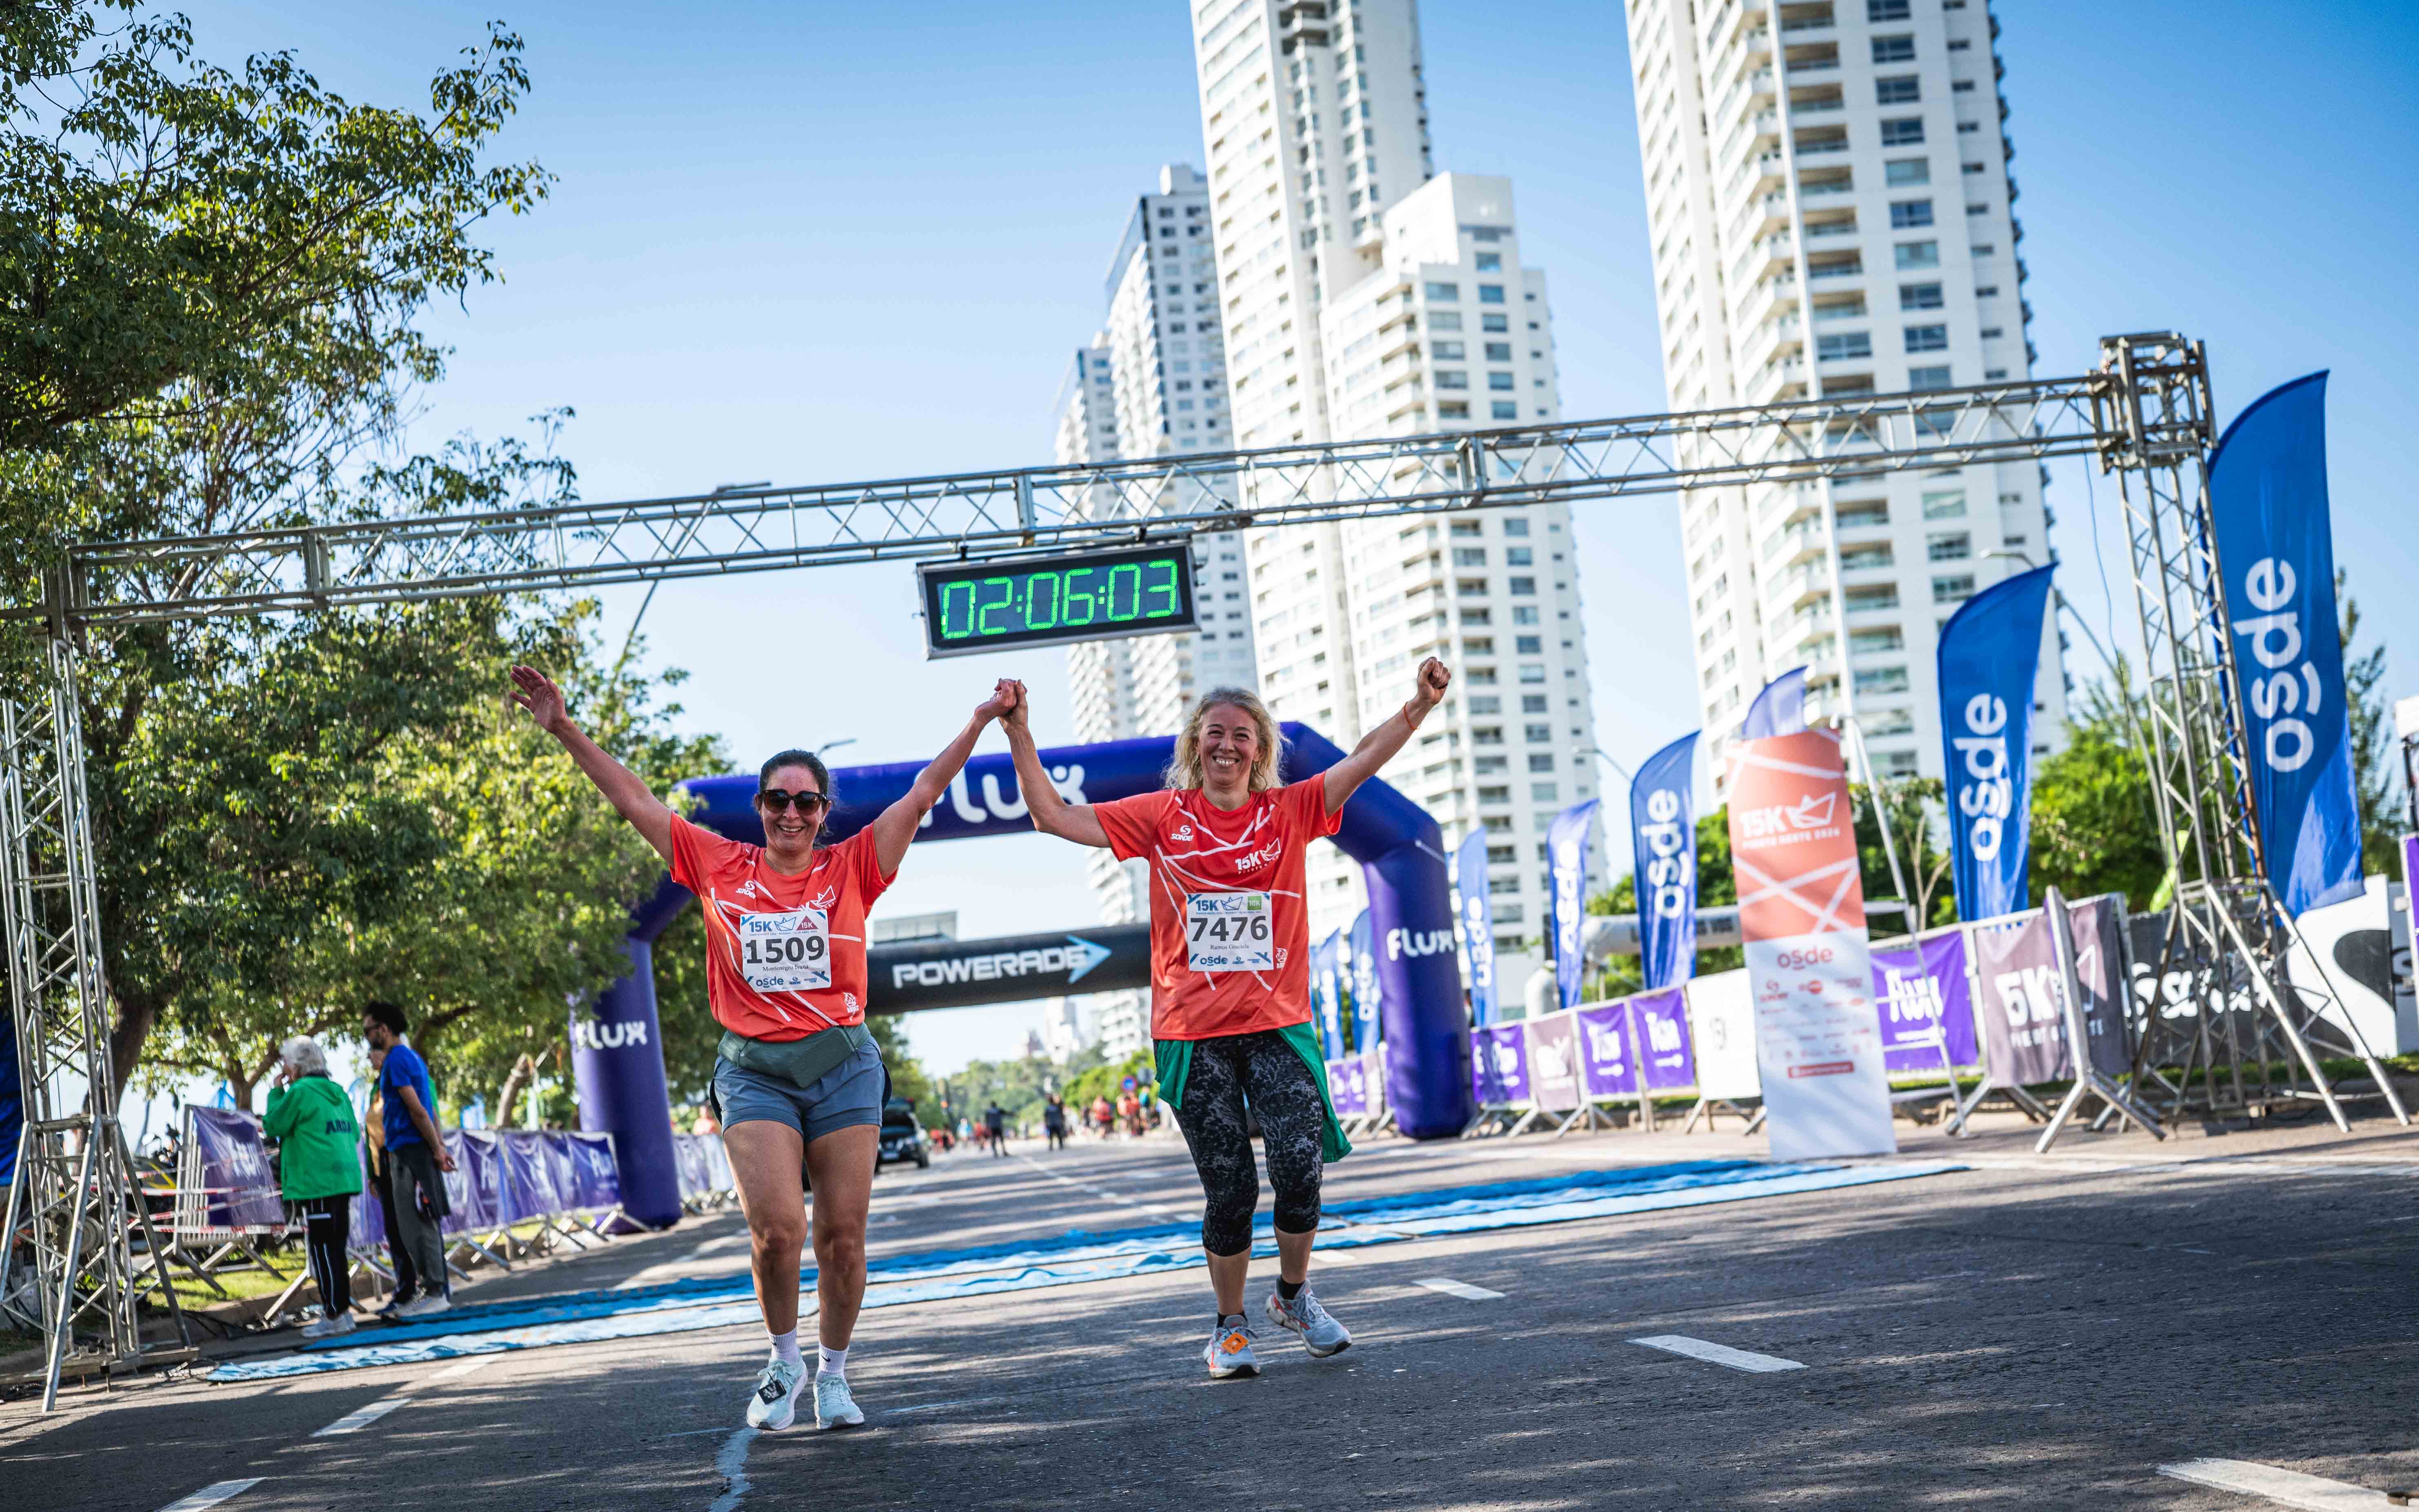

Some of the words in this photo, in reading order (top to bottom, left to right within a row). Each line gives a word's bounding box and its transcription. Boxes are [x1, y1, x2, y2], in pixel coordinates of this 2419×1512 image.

[942, 560, 1178, 639] 02:06:03
[2232, 557, 2321, 773] osde
[1953, 693, 2012, 861] osde
[1235, 851, 1261, 870] 15K
[1640, 789, 1690, 919] osde
[1196, 899, 1219, 911] 15K
[749, 920, 773, 933] 15K
[1190, 915, 1268, 941] 7476
[746, 936, 825, 964] 1509
[1386, 928, 1455, 961] flux
[892, 944, 1090, 989] POWERADE
[1200, 955, 1228, 966] osde
[1777, 946, 1833, 971] osde
[755, 976, 784, 988] osde
